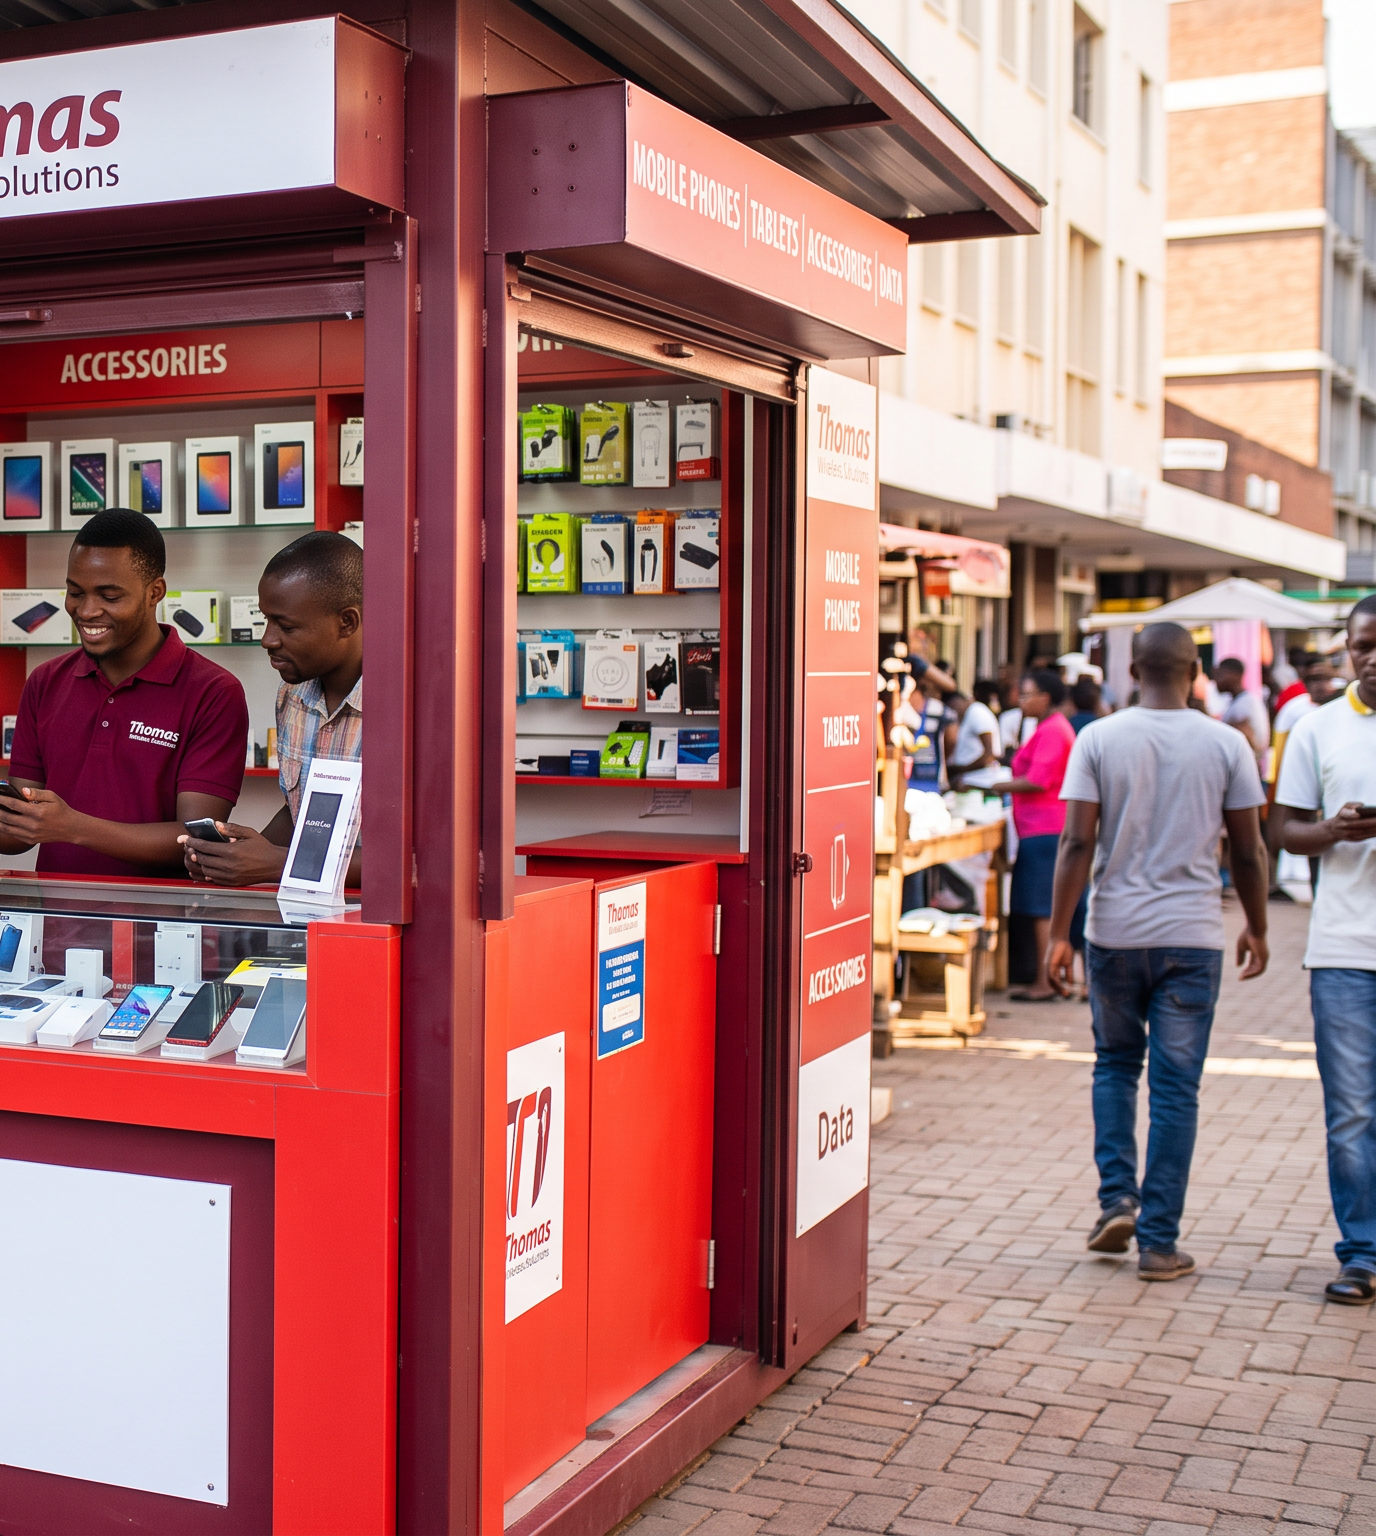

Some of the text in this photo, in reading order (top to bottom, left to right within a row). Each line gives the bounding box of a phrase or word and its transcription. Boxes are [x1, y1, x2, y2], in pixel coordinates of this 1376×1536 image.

[633, 140, 903, 306] MOBILE PHONES TABLETS ACCESSORIES DATA
[60, 343, 228, 384] ACCESSORIES
[817, 403, 871, 461] Thomas
[825, 549, 860, 585] MOBILE
[824, 598, 861, 633] PHONES
[823, 714, 860, 748] TABLETS
[818, 1103, 854, 1161] Data
